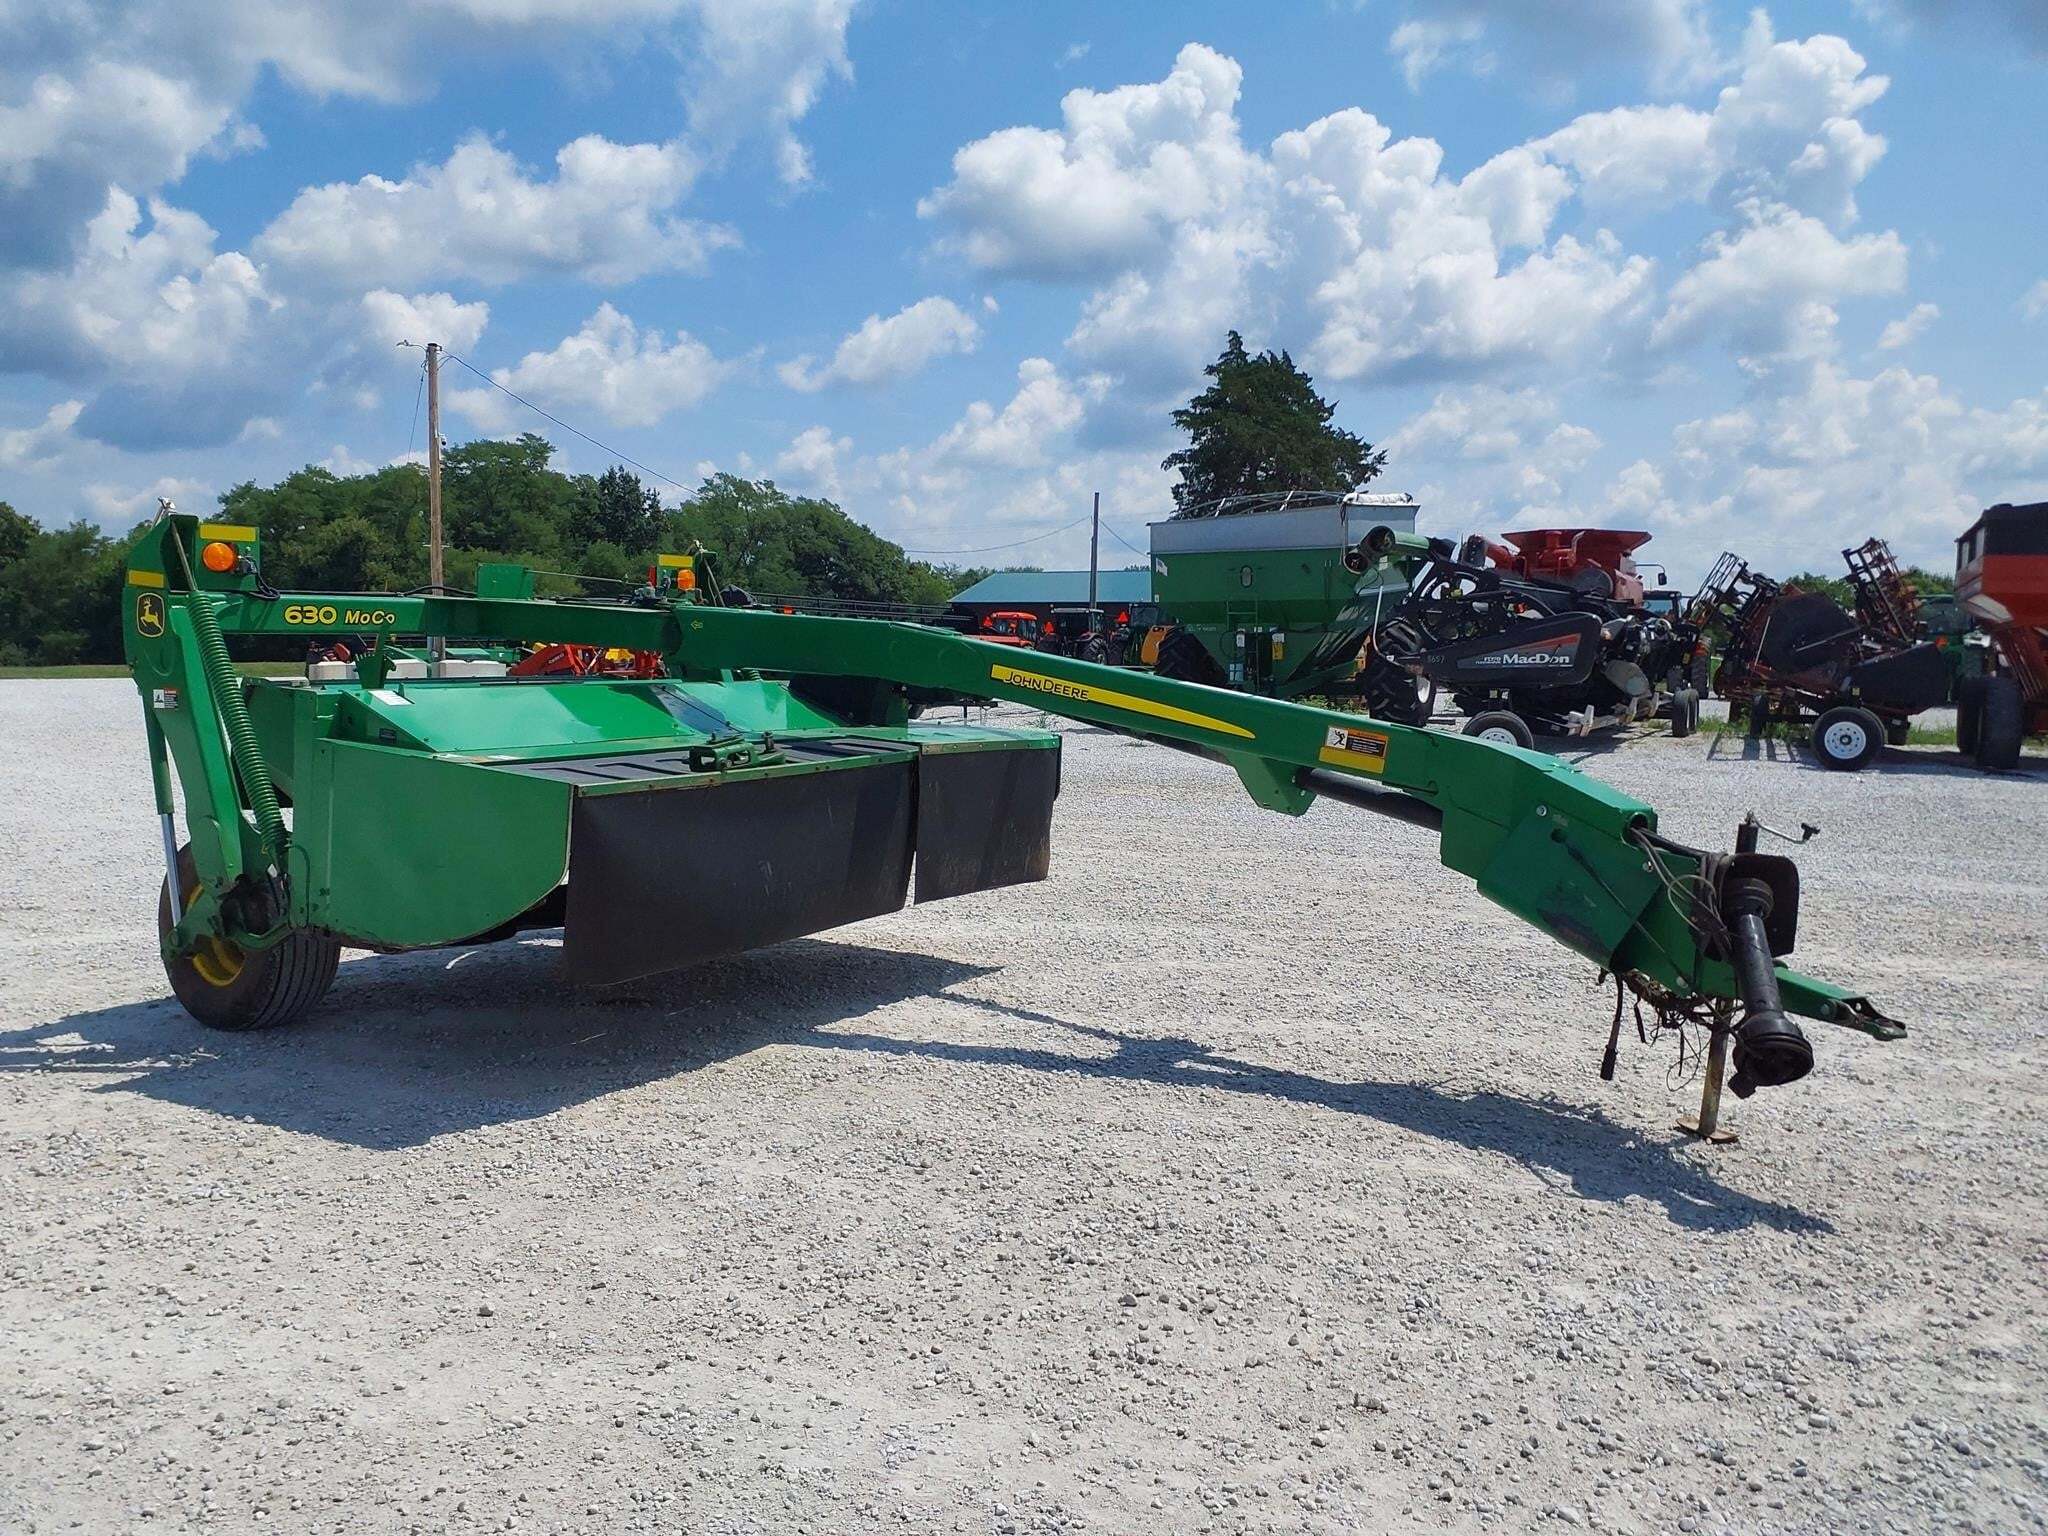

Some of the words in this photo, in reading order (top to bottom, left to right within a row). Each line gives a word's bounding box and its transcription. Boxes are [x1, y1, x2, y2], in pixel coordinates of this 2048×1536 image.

[284, 604, 338, 625] 630
[344, 610, 396, 624] MoCo
[1502, 653, 1570, 664] MacDon
[1004, 671, 1041, 690] JOHN
[1042, 679, 1089, 700] DEERE
